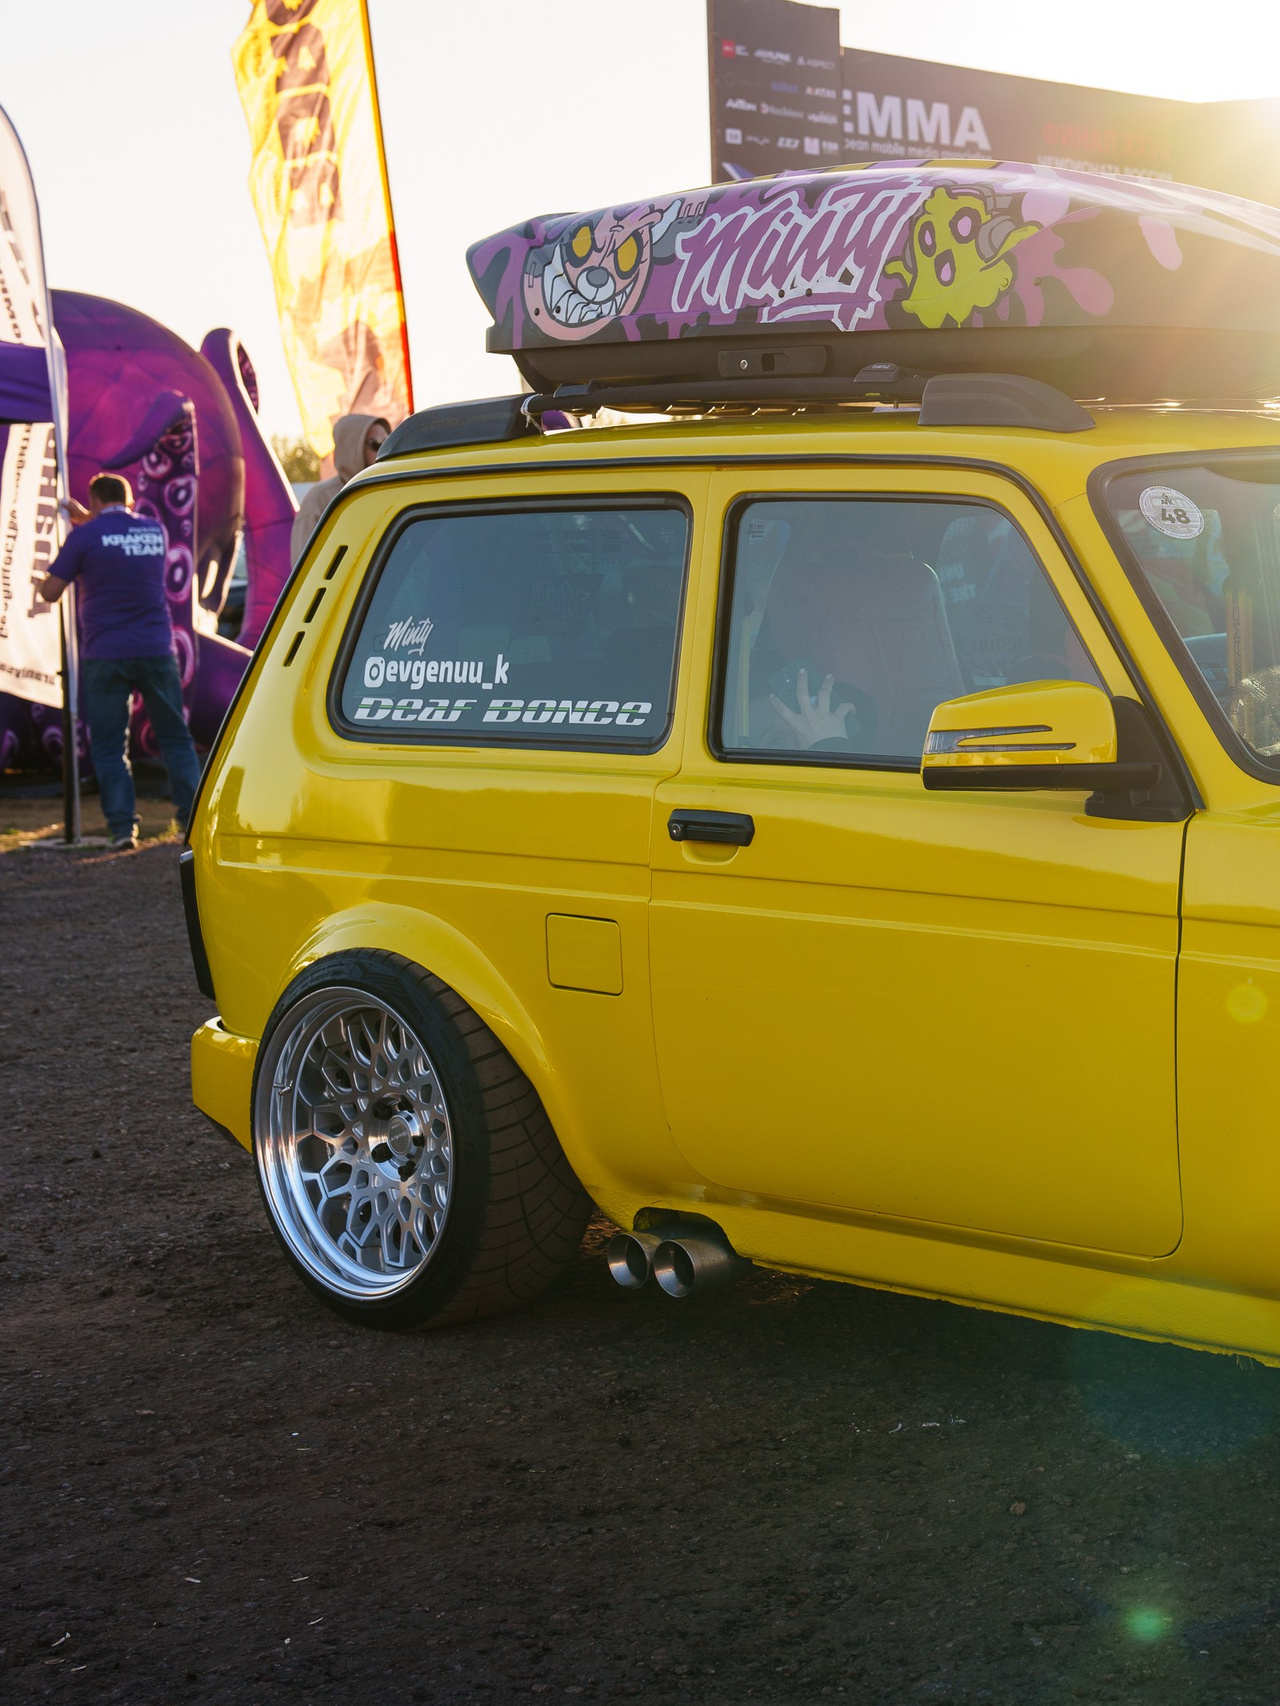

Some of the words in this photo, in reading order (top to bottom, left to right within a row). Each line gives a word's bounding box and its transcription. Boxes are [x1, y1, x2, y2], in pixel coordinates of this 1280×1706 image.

[1161, 508, 1191, 525] 48
[101, 533, 163, 547] KRAKEN
[122, 544, 164, 557] TEAM
[382, 615, 434, 656] Minty
[385, 654, 510, 690] evgenuu_k
